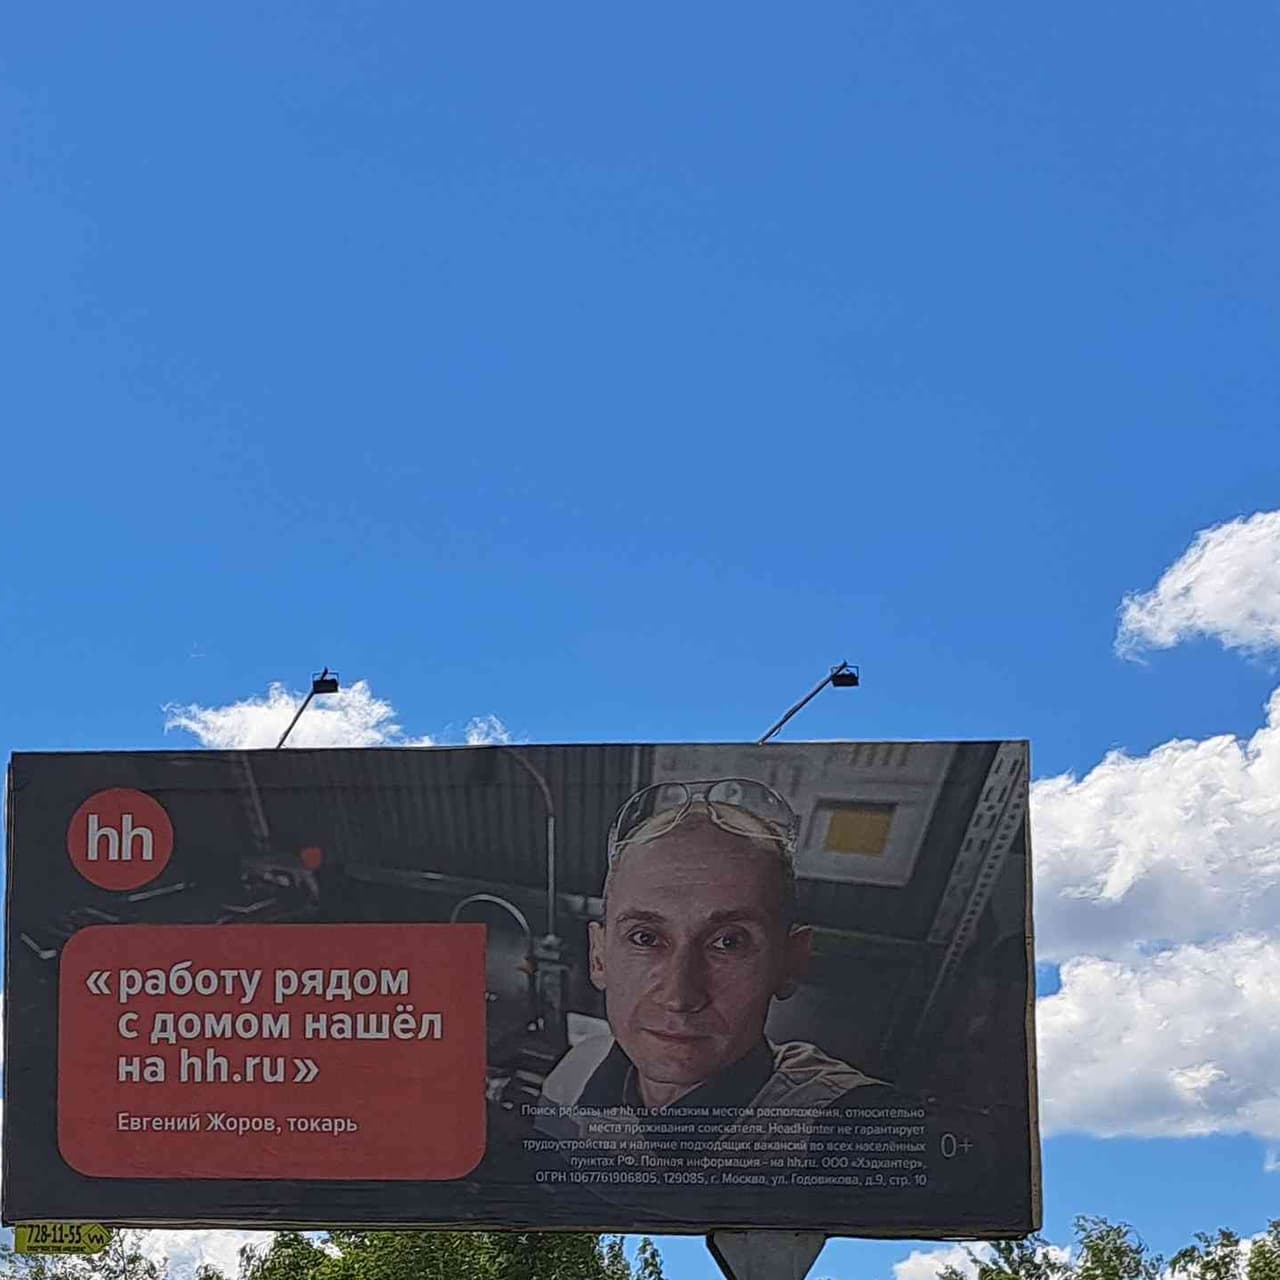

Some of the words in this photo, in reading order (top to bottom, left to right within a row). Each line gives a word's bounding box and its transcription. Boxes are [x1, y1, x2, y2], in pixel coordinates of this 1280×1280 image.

[86, 814, 154, 861] hh
[274, 968, 409, 1003] рядом
[118, 1012, 139, 1039] с
[150, 1011, 290, 1044] домом
[305, 1004, 443, 1040] нашёл
[117, 1056, 166, 1082] на
[521, 1104, 556, 1116] Поиск
[559, 1105, 600, 1118] работы
[603, 1107, 617, 1117] на
[659, 1105, 709, 1117] близким
[712, 1107, 755, 1117] местом
[845, 1107, 926, 1118] относительно
[117, 1111, 200, 1132] Евгений
[206, 1112, 282, 1135] Жоров,
[287, 1116, 358, 1136] токарь
[588, 1123, 622, 1133] места
[625, 1123, 695, 1135] проживания
[768, 1122, 834, 1135] HeadHunter
[837, 1126, 852, 1135] не
[854, 1125, 926, 1138] гарантирует
[522, 1138, 617, 1151] трудоустройства
[619, 1140, 627, 1150] и
[629, 1141, 678, 1150] наличие
[680, 1141, 751, 1152] подходящих
[826, 1142, 853, 1151] всех
[941, 1133, 974, 1158] 0+
[570, 1156, 615, 1168] пунктах
[640, 1155, 684, 1167] Полная
[770, 1158, 784, 1167] на
[821, 1157, 849, 1168] ООО
[535, 1171, 567, 1182] ОГРН
[913, 1174, 928, 1186] 10
[27, 1225, 82, 1244] 728-11-55
